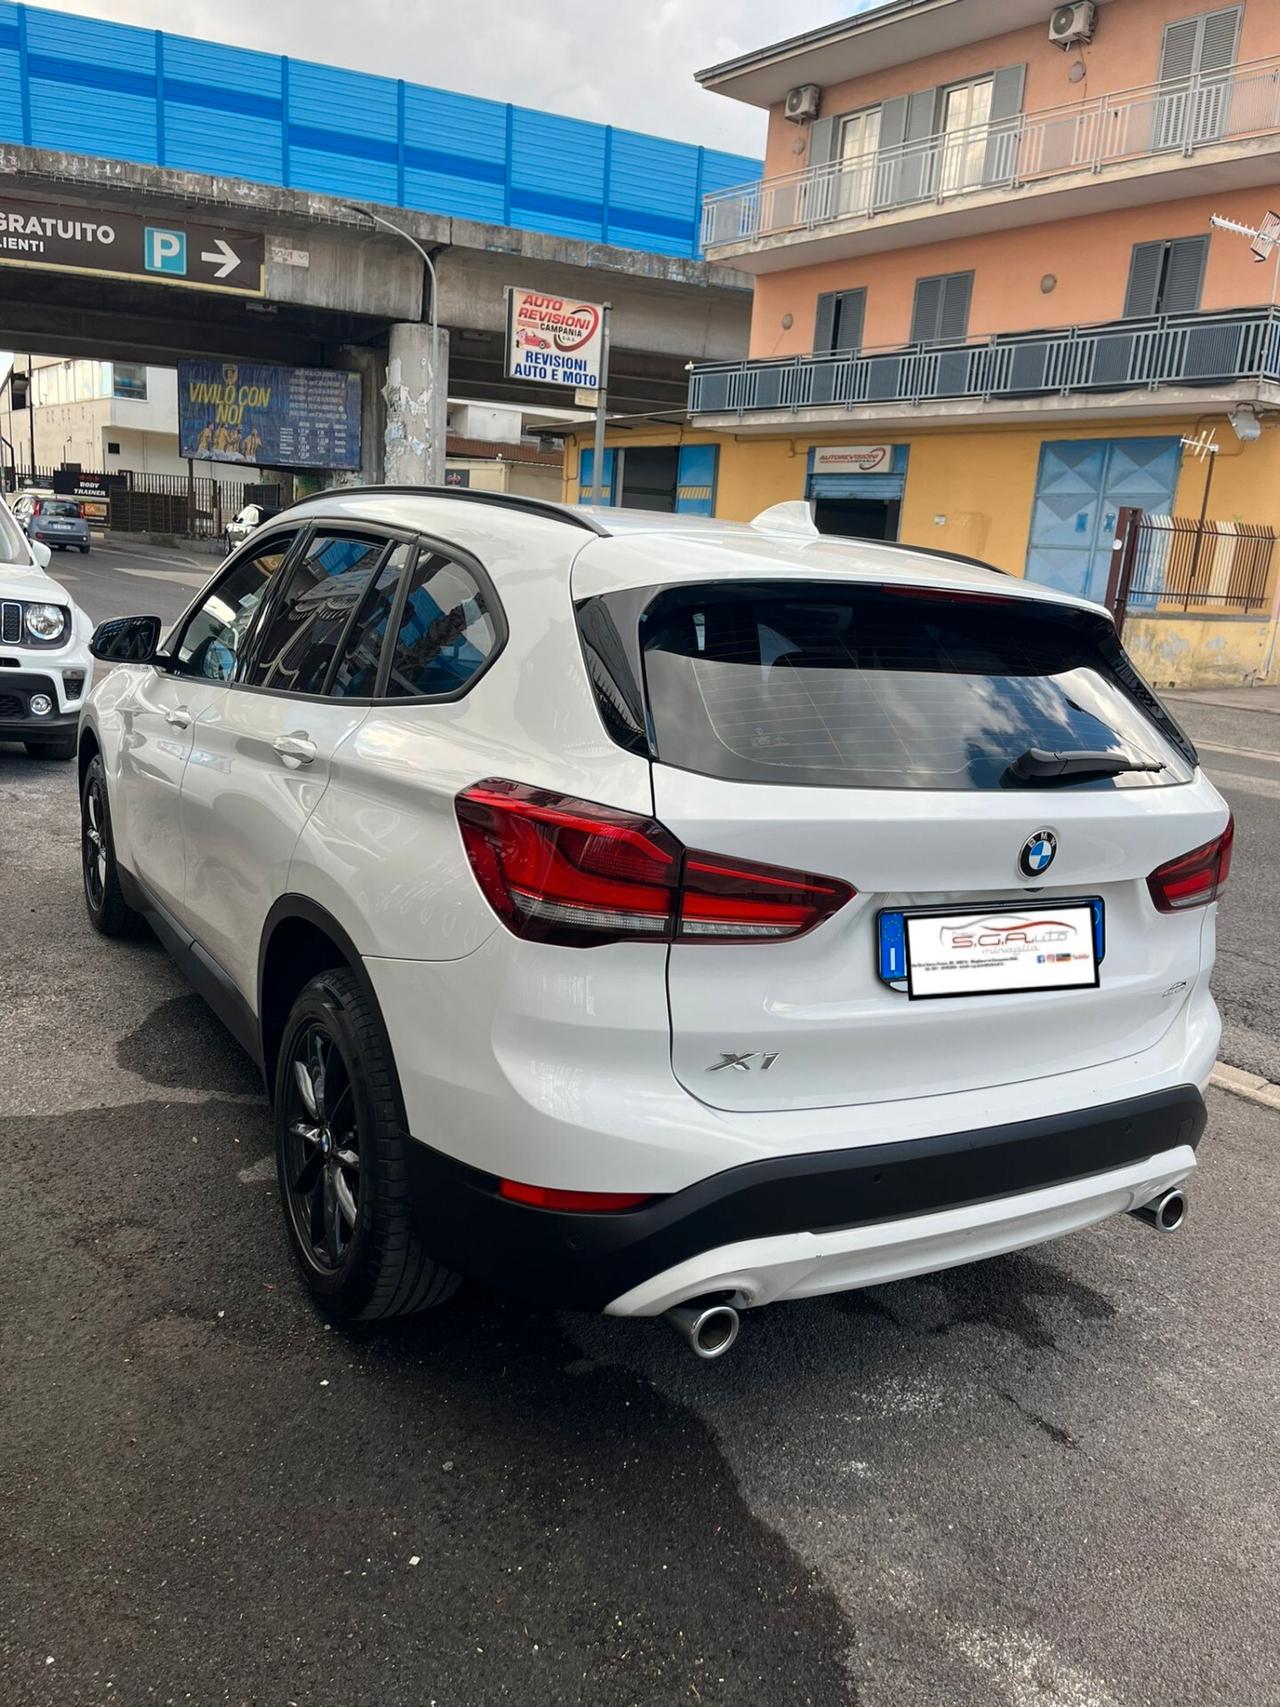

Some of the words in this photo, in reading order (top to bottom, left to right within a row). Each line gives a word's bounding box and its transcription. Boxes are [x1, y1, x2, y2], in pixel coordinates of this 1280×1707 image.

[0, 236, 44, 253] IENTI
[153, 232, 180, 268] P
[522, 294, 563, 311] AUTO
[518, 307, 591, 330] REVISIONI
[540, 323, 582, 338] CAMPANIA
[525, 351, 587, 372] REVISIONI
[514, 363, 547, 379] AUTO
[551, 369, 559, 381] E
[562, 370, 597, 387] MOTO
[189, 382, 236, 405] VIVILO
[238, 385, 271, 408] CON
[215, 404, 244, 425] NOI
[73, 488, 106, 497] TRAINER
[79, 481, 100, 489] BODY
[1028, 832, 1057, 848] BMW
[704, 1052, 780, 1072] X1
